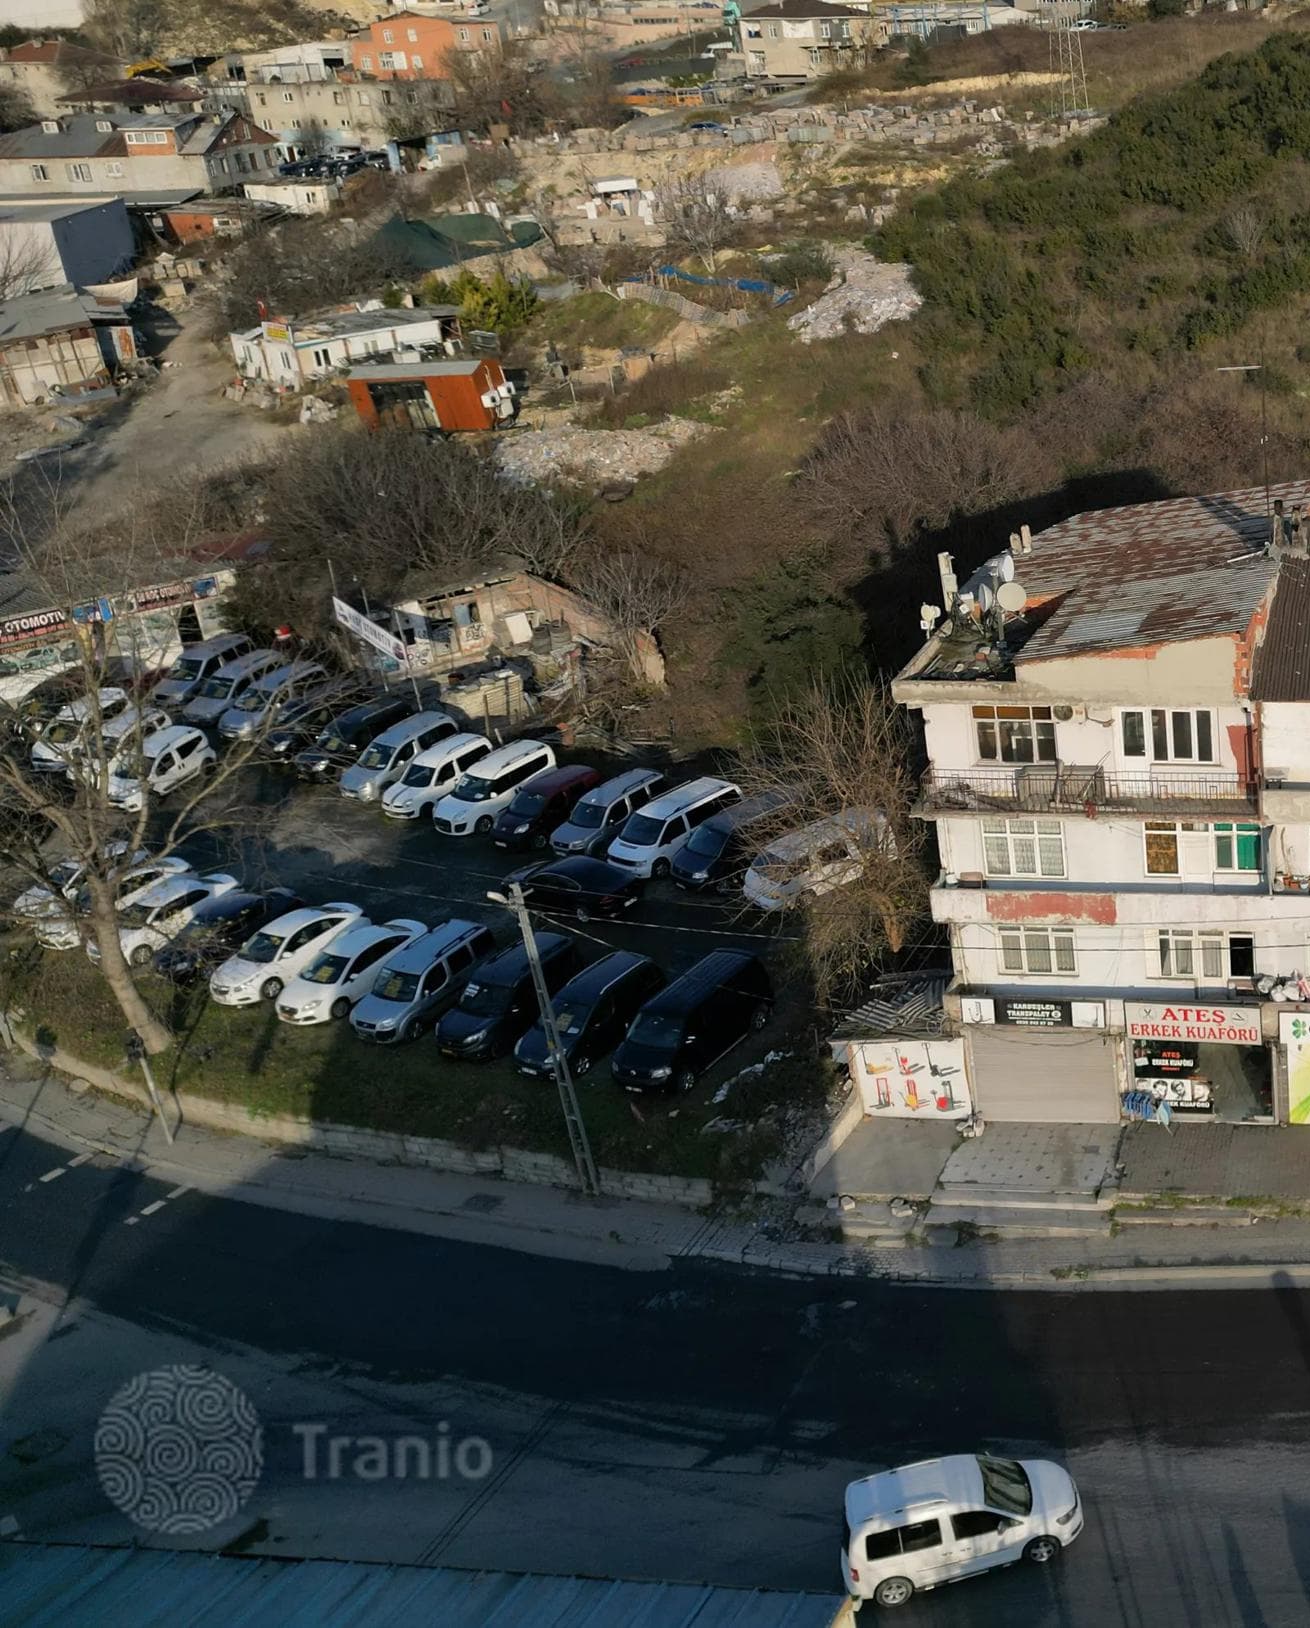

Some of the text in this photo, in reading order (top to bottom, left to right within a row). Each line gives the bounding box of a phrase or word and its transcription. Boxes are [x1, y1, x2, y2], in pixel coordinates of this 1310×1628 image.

[1161, 1008, 1226, 1025] ATEŞ
[1131, 1024, 1258, 1041] ERKEK KUAFÖRÜ
